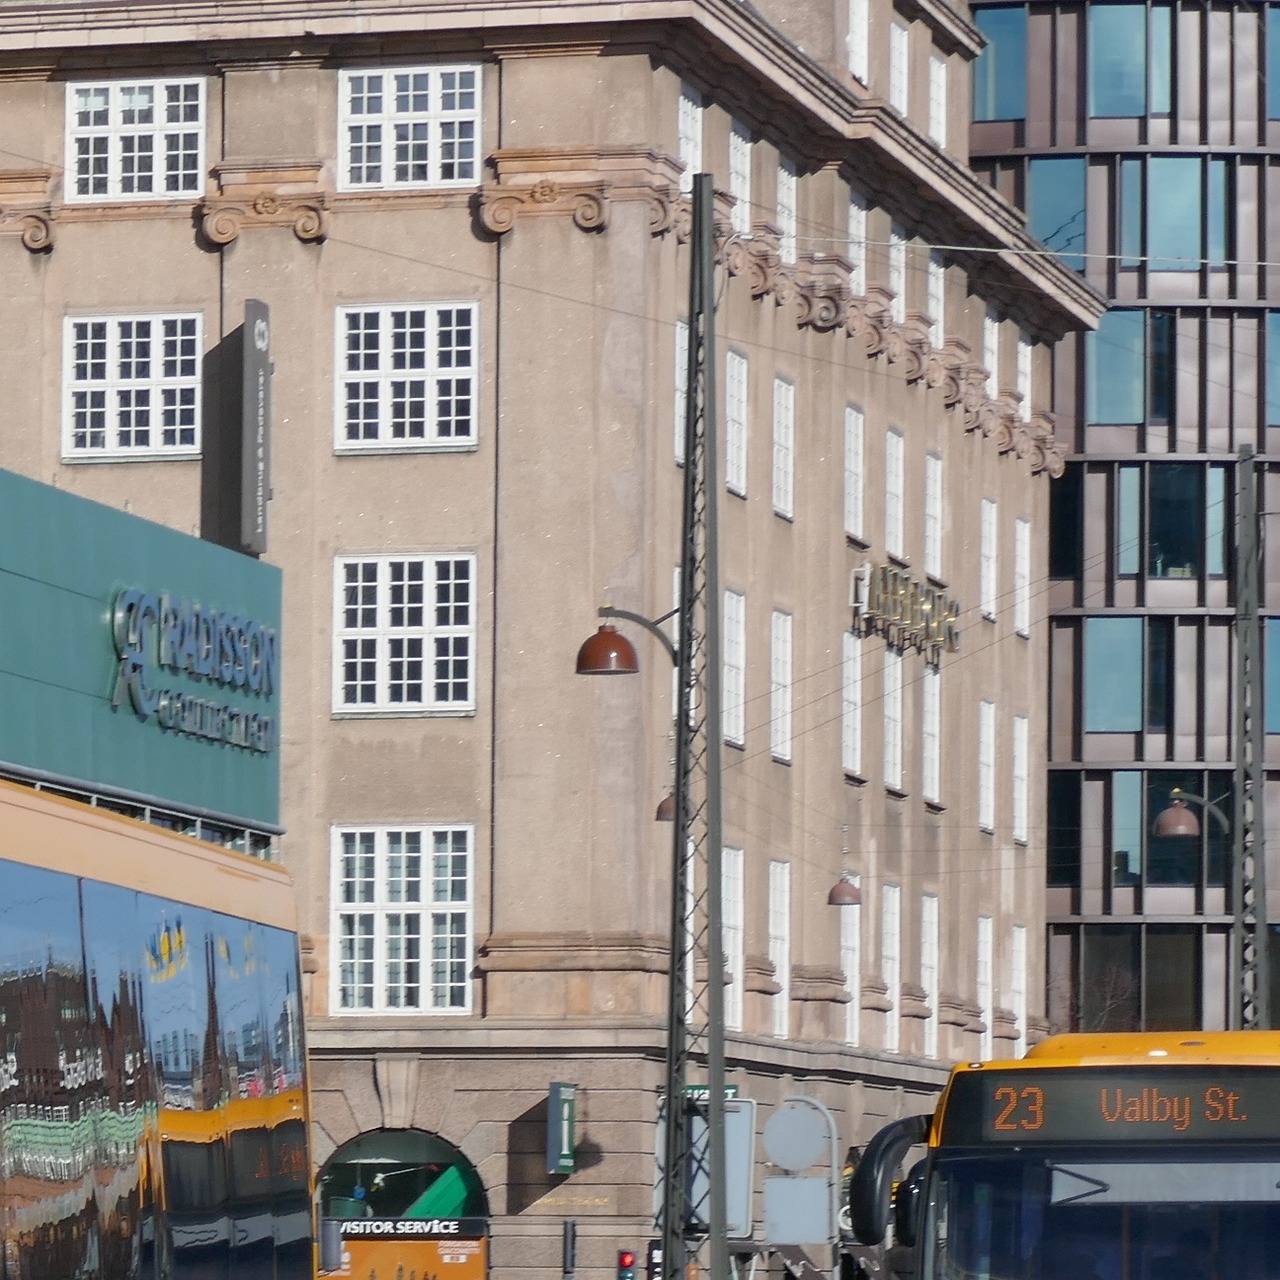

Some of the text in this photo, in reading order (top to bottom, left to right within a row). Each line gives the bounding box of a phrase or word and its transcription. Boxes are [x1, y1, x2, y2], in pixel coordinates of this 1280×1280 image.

[993, 1086, 1248, 1131] 23 Valby St.
